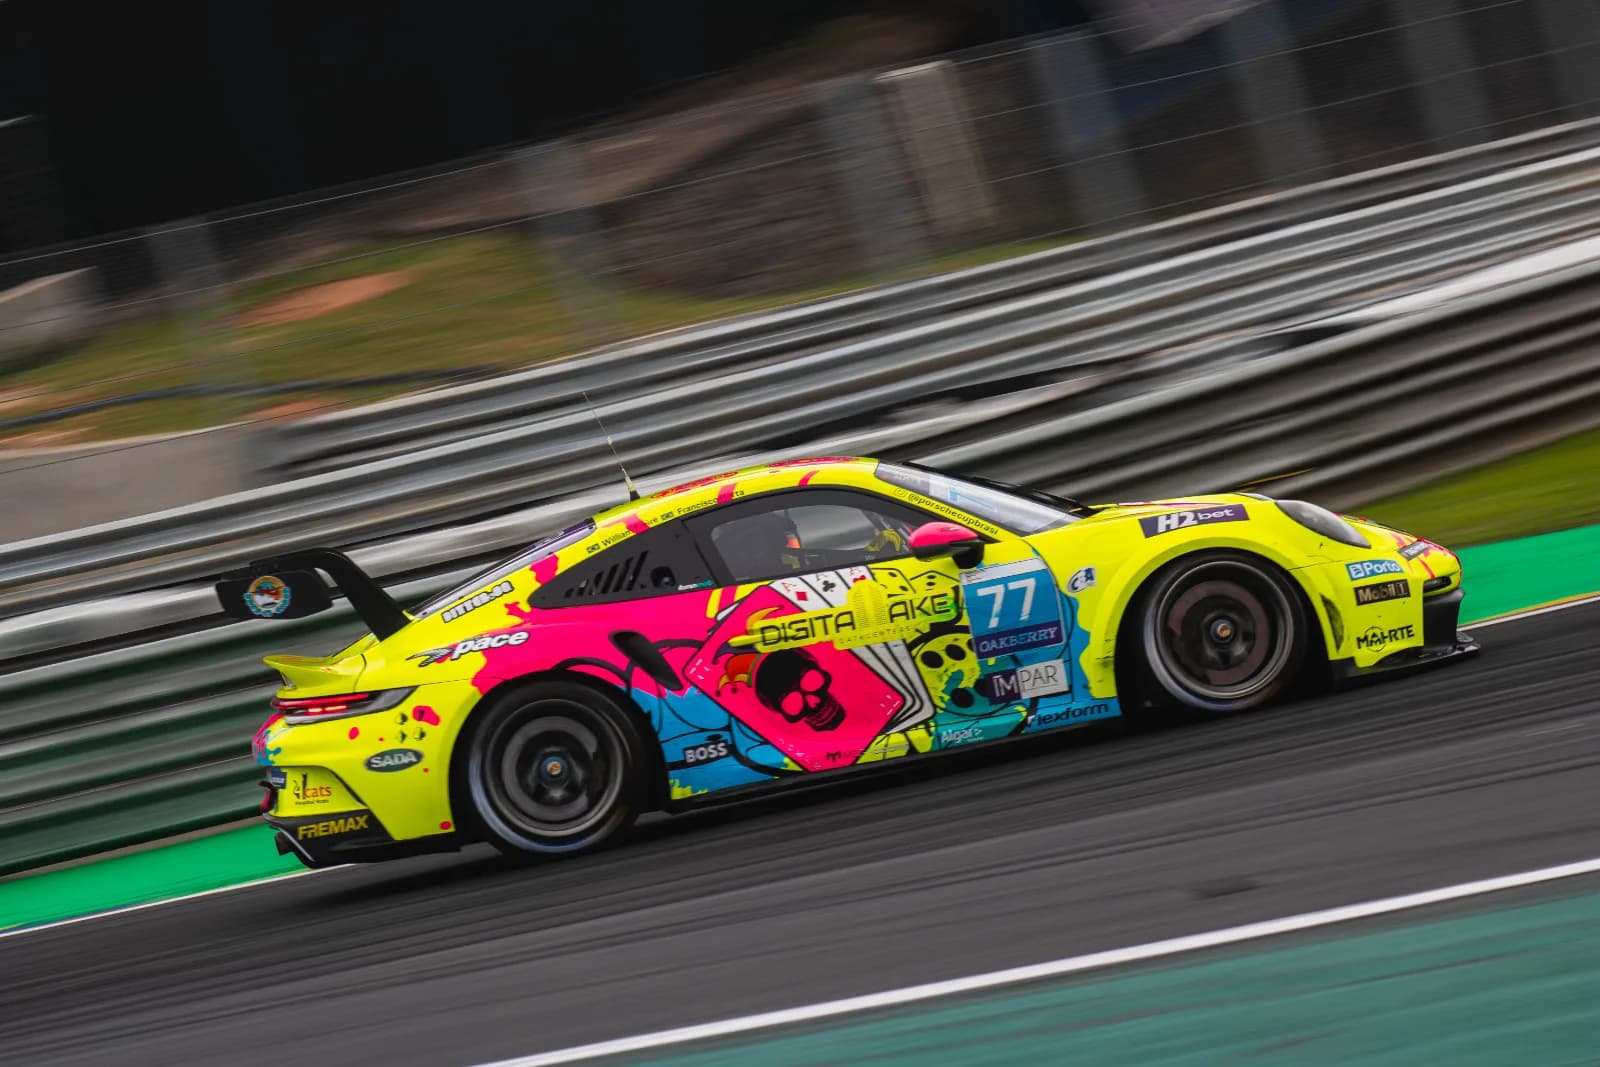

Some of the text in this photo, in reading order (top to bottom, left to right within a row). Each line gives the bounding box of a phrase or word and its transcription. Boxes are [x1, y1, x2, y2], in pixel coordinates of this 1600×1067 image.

[1363, 560, 1401, 577] Porto
[976, 577, 1036, 629] 77
[450, 630, 530, 661] pace
[979, 626, 1059, 653] OAKBERRY
[369, 750, 418, 769] SADA
[684, 741, 729, 764] BOSS
[298, 814, 369, 841] FREMAX
